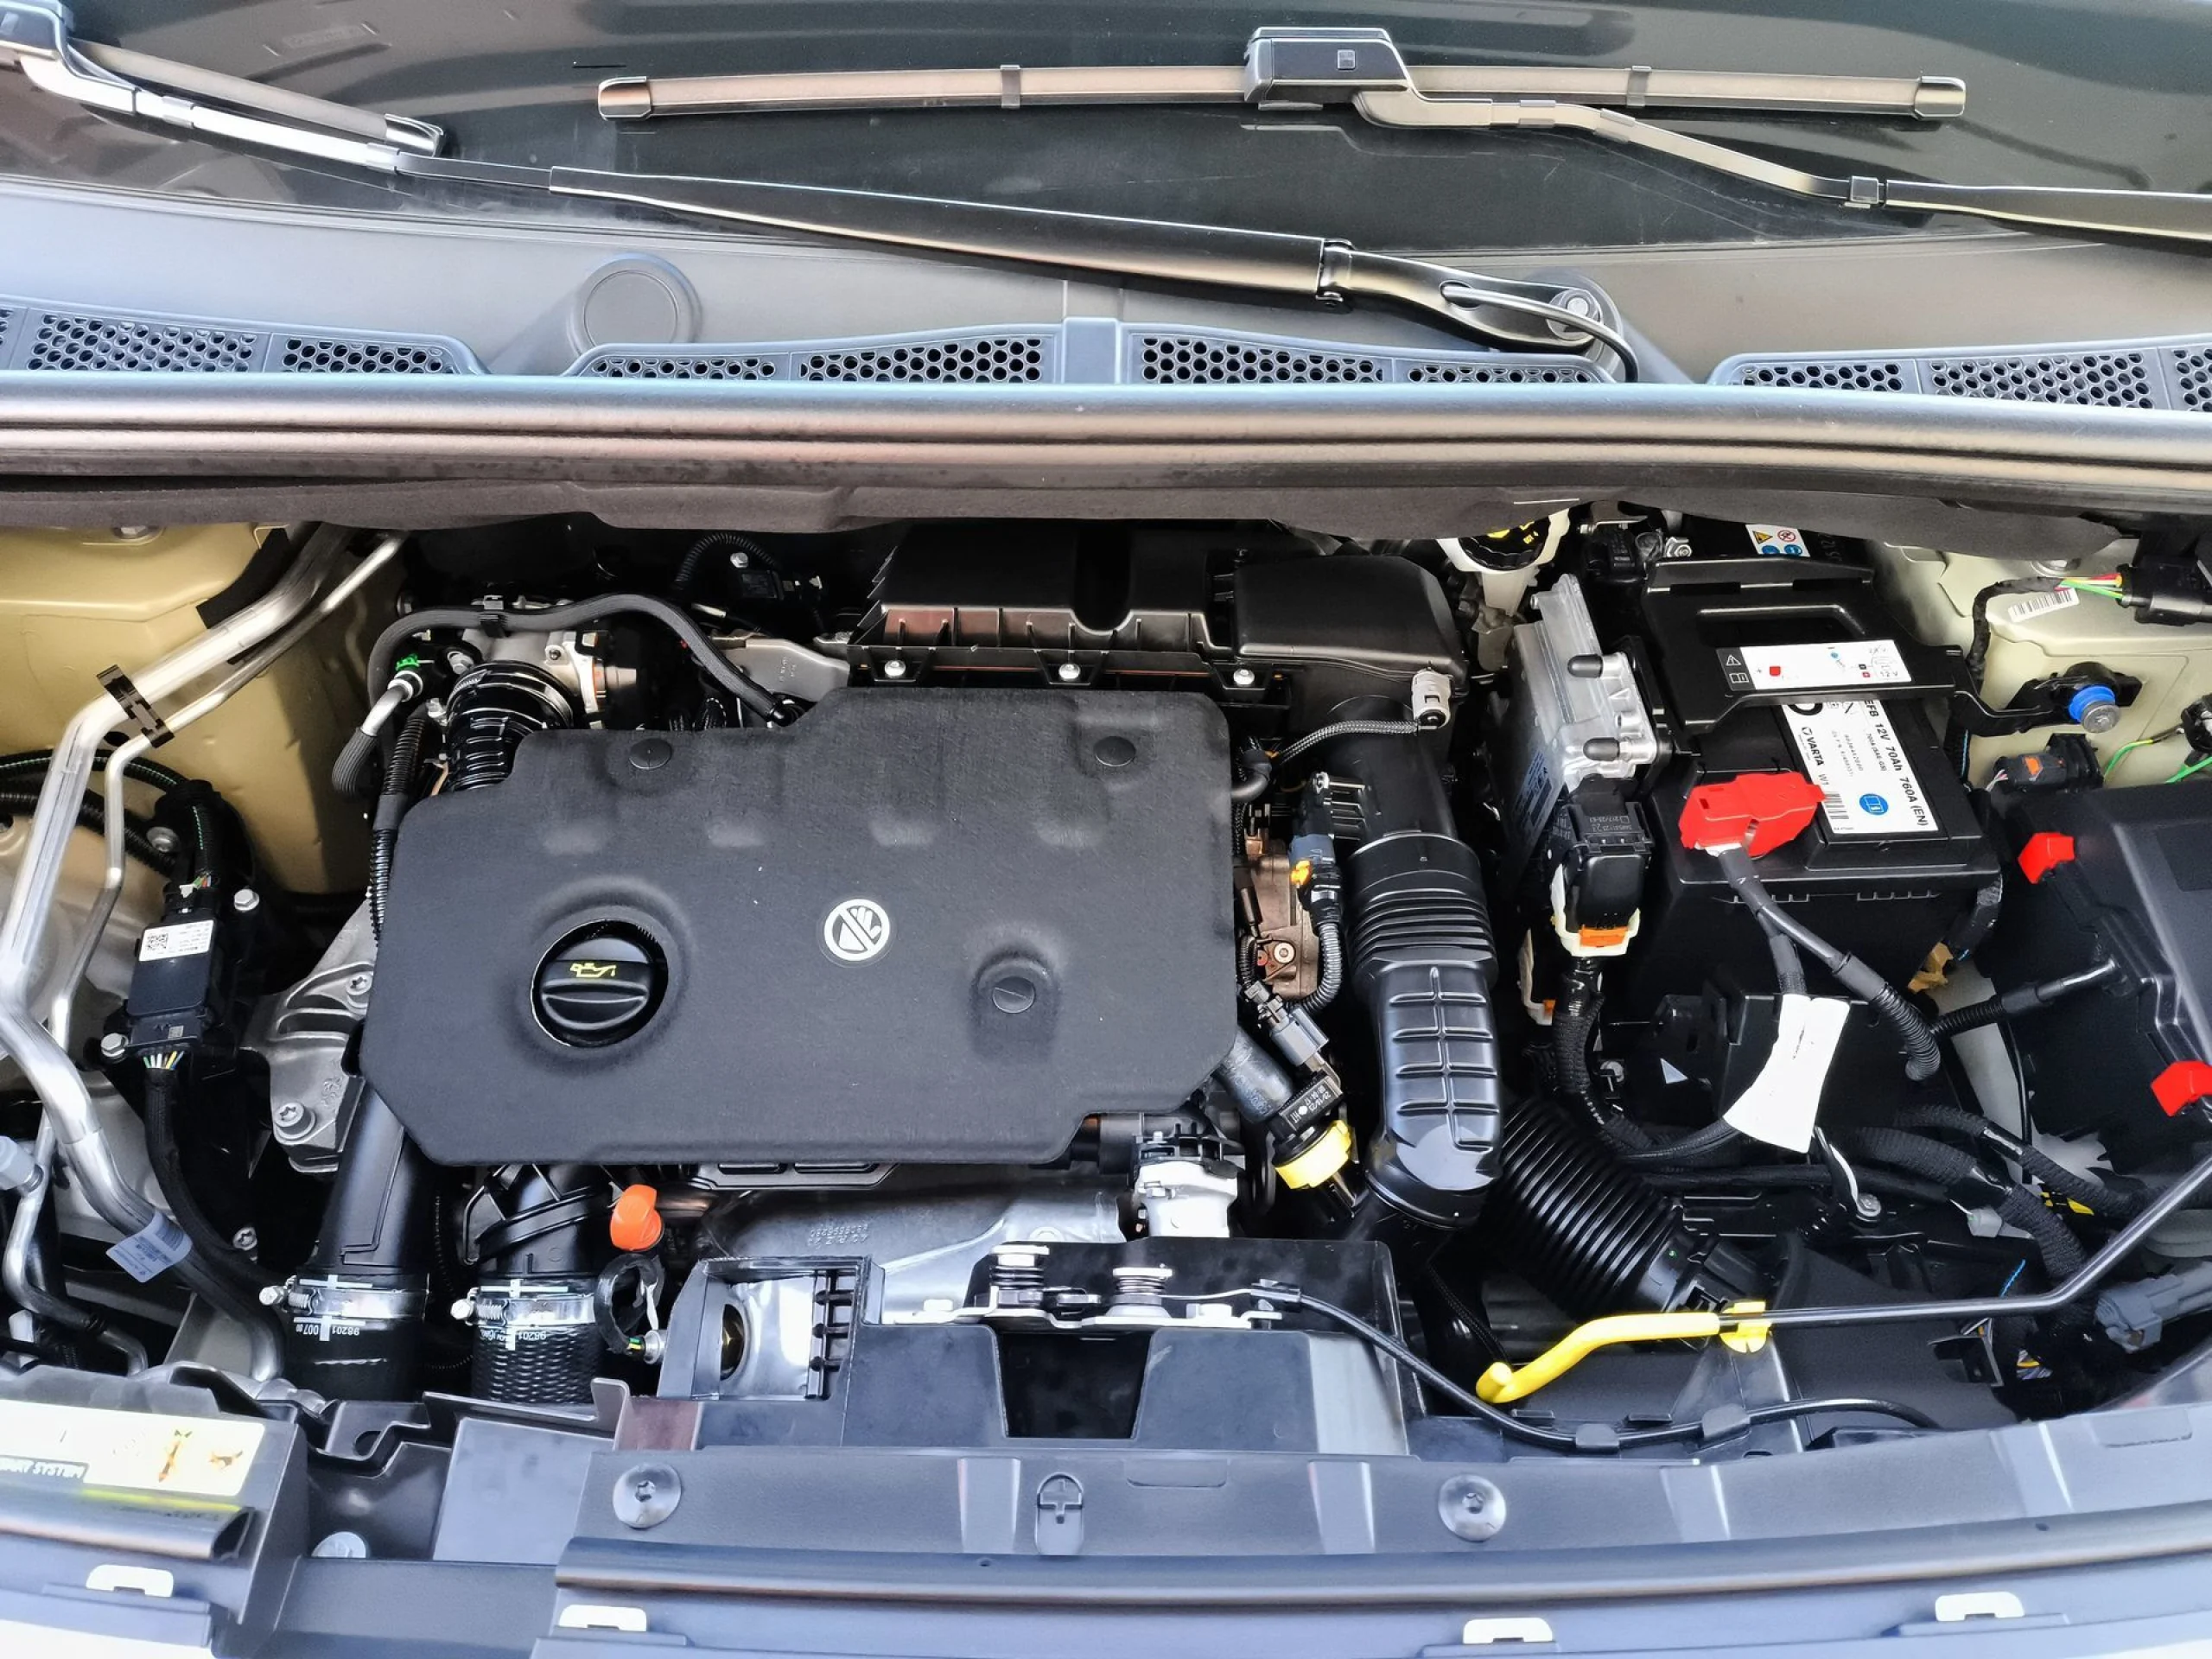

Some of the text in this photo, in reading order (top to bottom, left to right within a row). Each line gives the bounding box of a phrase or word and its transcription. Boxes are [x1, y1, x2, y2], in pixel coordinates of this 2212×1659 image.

[1807, 736, 1825, 766] VARTA
[1875, 722, 1891, 741] 12V
[1885, 746, 1902, 772] 70Ah
[1899, 777, 1918, 803] 760A
[1910, 804, 1929, 826] (EN)
[332, 1325, 360, 1337] 98201
